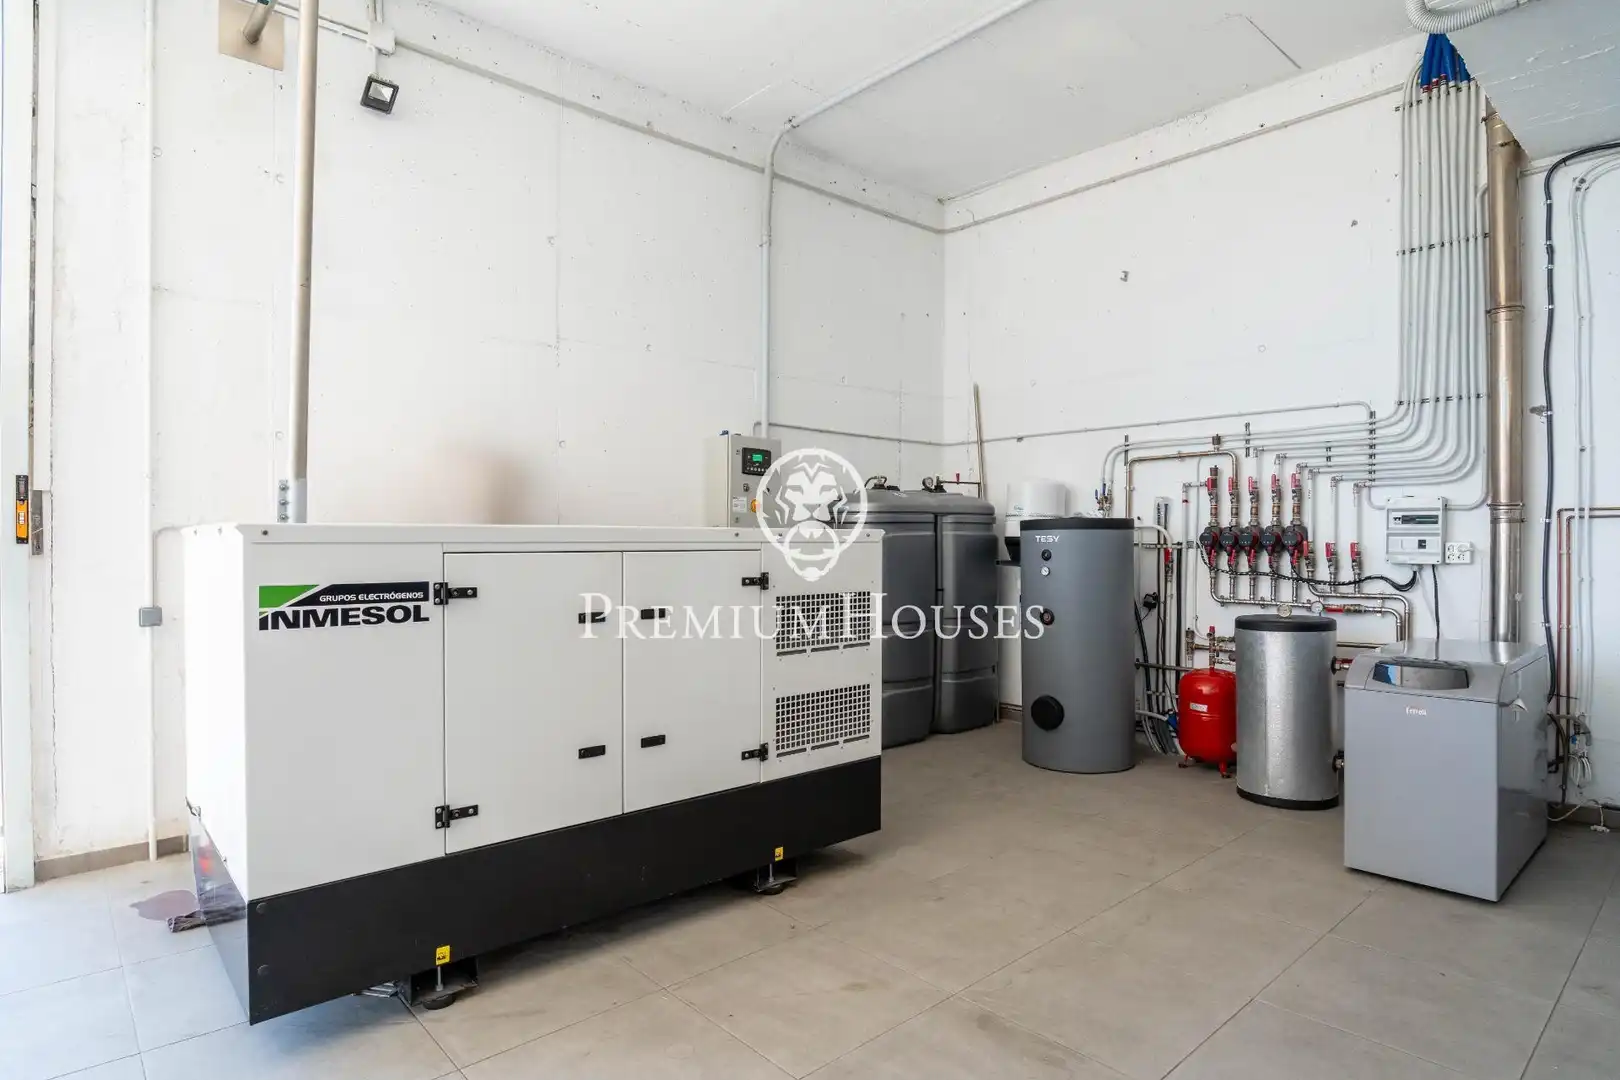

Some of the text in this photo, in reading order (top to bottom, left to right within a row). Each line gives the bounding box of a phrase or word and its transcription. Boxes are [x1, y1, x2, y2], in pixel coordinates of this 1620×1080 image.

[1035, 535, 1060, 543] TESY
[319, 590, 424, 602] GRUPOS ELECTRÓGENOS
[258, 604, 430, 631] INMESOL
